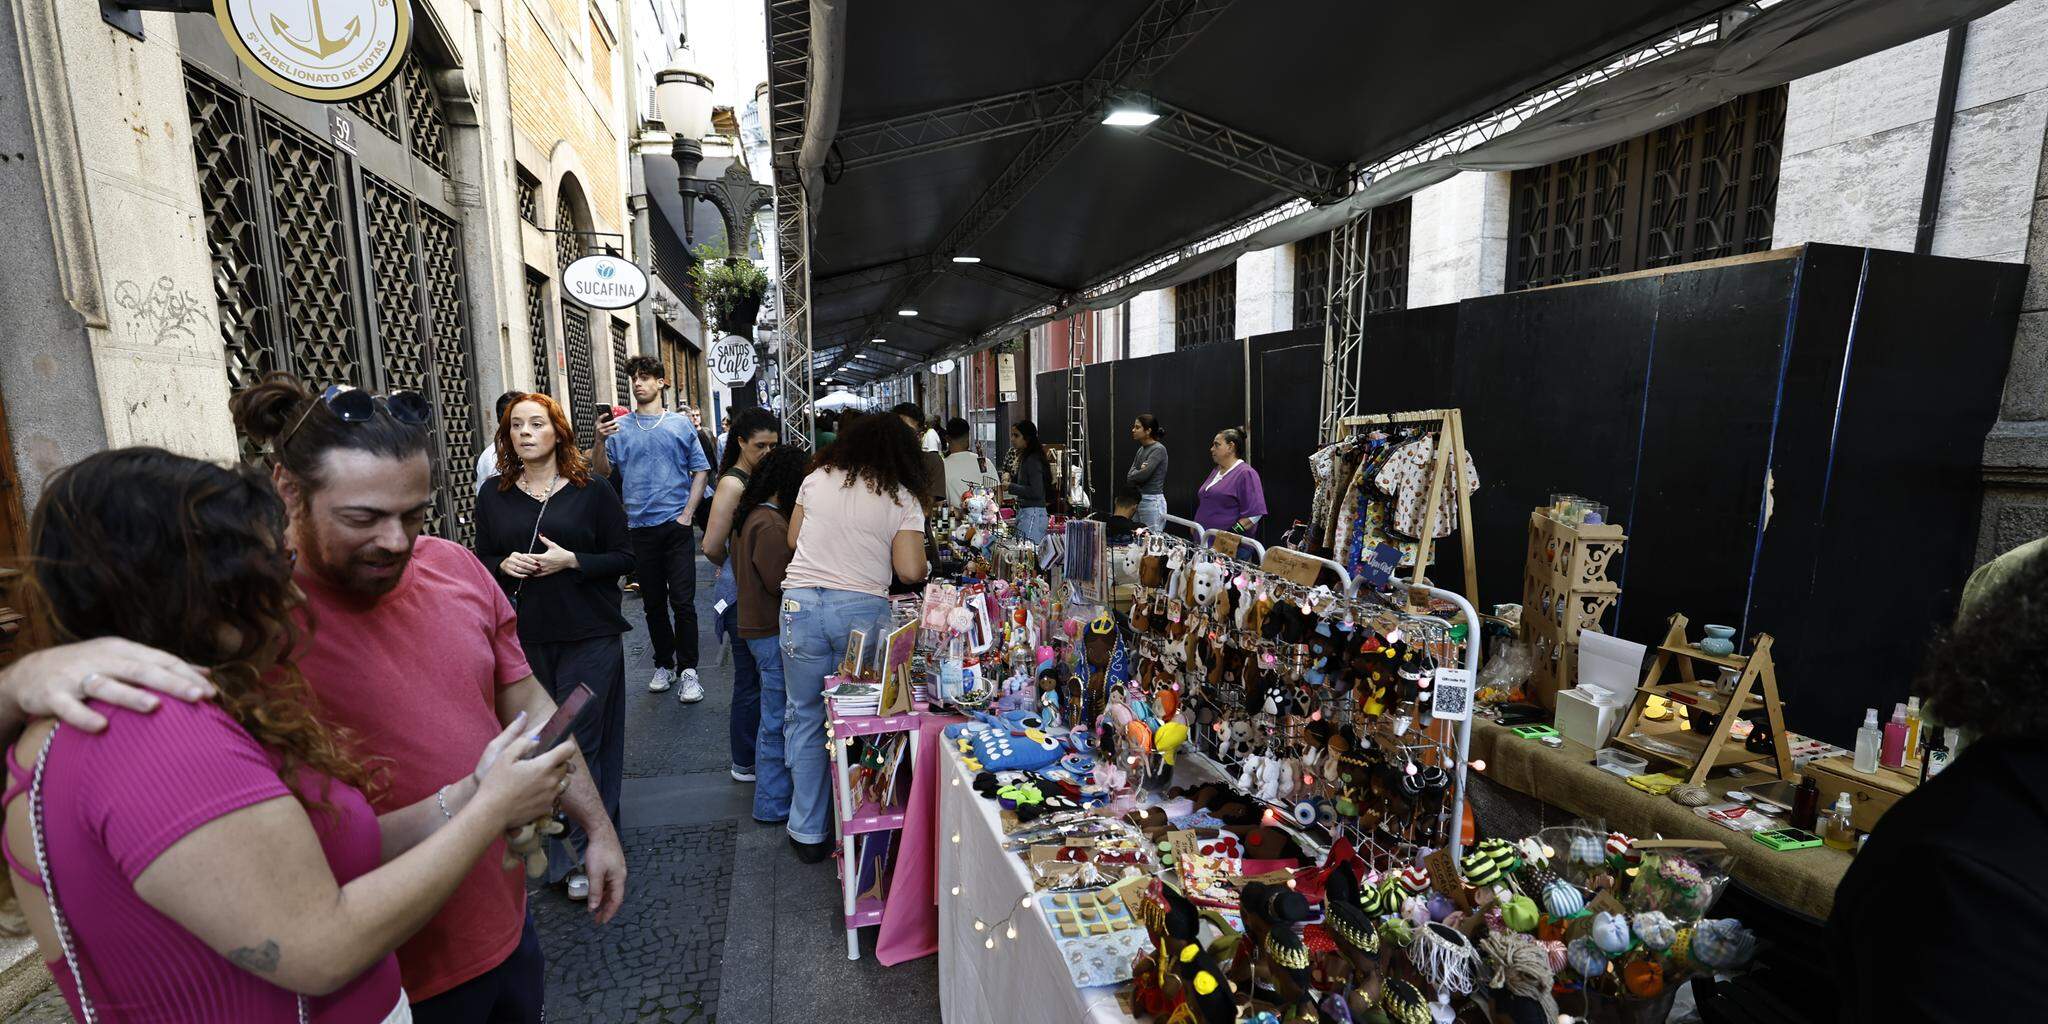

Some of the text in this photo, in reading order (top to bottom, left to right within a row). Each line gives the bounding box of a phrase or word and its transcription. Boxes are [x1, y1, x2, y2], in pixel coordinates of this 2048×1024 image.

[258, 44, 340, 83] TABELIONATO
[342, 67, 358, 81] DE
[359, 39, 387, 72] NOTAS
[336, 116, 350, 142] 59
[576, 280, 636, 298] SUCAFINA
[717, 343, 750, 357] SANTOS
[718, 354, 750, 379] Café
